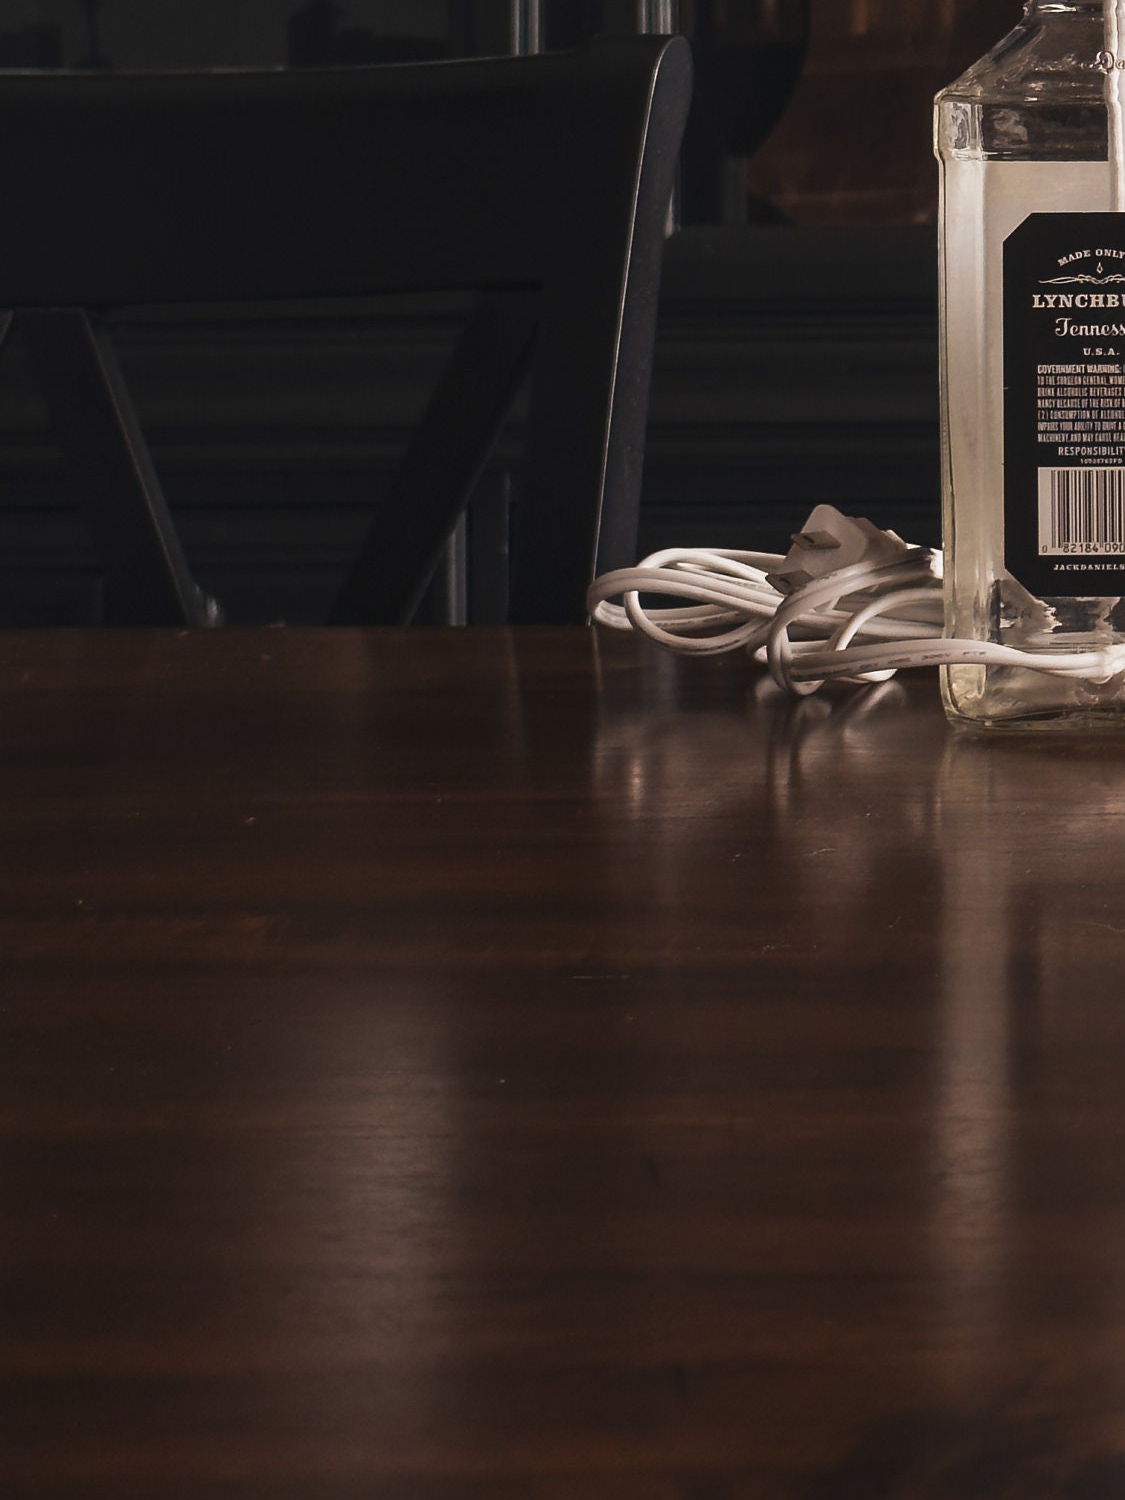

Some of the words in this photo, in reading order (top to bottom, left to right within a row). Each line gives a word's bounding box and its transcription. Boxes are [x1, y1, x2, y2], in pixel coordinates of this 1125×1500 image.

[1057, 249, 1091, 267] MADE
[1095, 248, 1125, 259] ONLY
[1083, 347, 1120, 356] U.S.A.
[1038, 364, 1085, 374] GOVERNMENT
[1063, 543, 1099, 553] 82184
